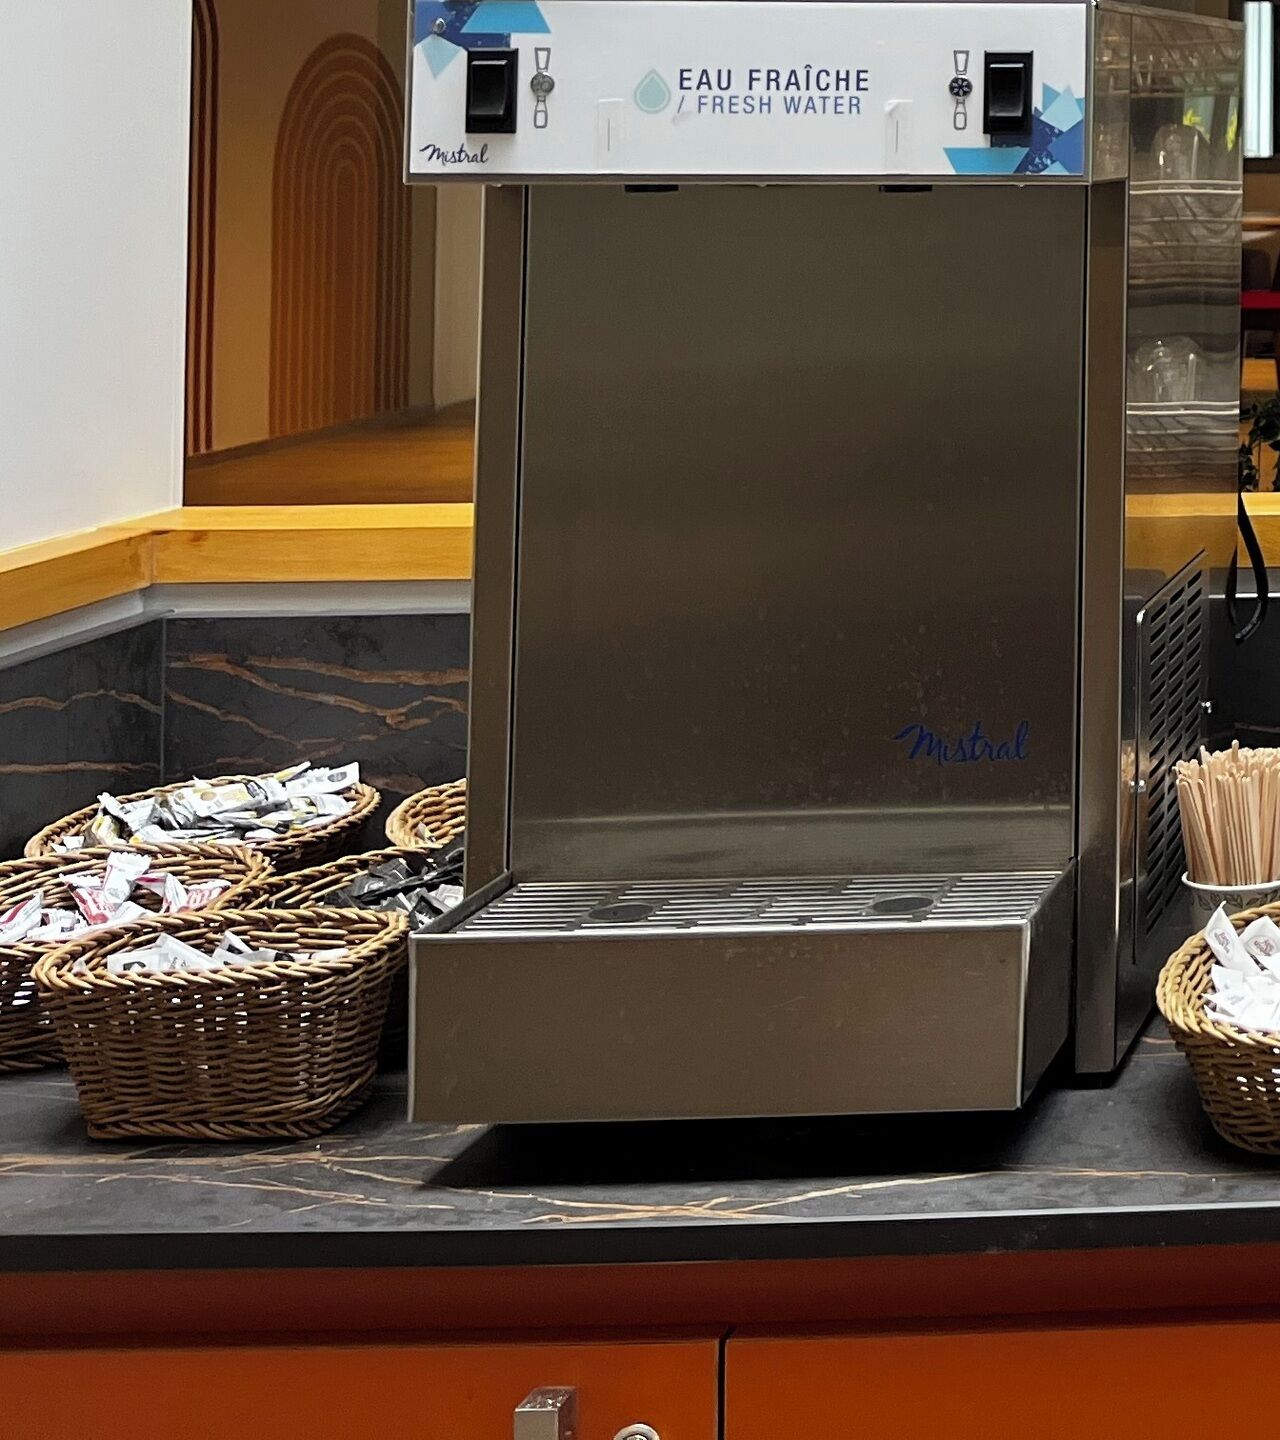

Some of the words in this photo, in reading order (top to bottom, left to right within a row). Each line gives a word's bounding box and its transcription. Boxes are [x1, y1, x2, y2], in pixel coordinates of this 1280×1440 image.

[678, 70, 735, 92] EAU
[748, 63, 870, 92] FRAÎCHE
[696, 95, 771, 115] FRESH
[783, 95, 862, 115] WATER
[419, 143, 490, 166] Mistral
[892, 720, 1031, 766] Mistral
